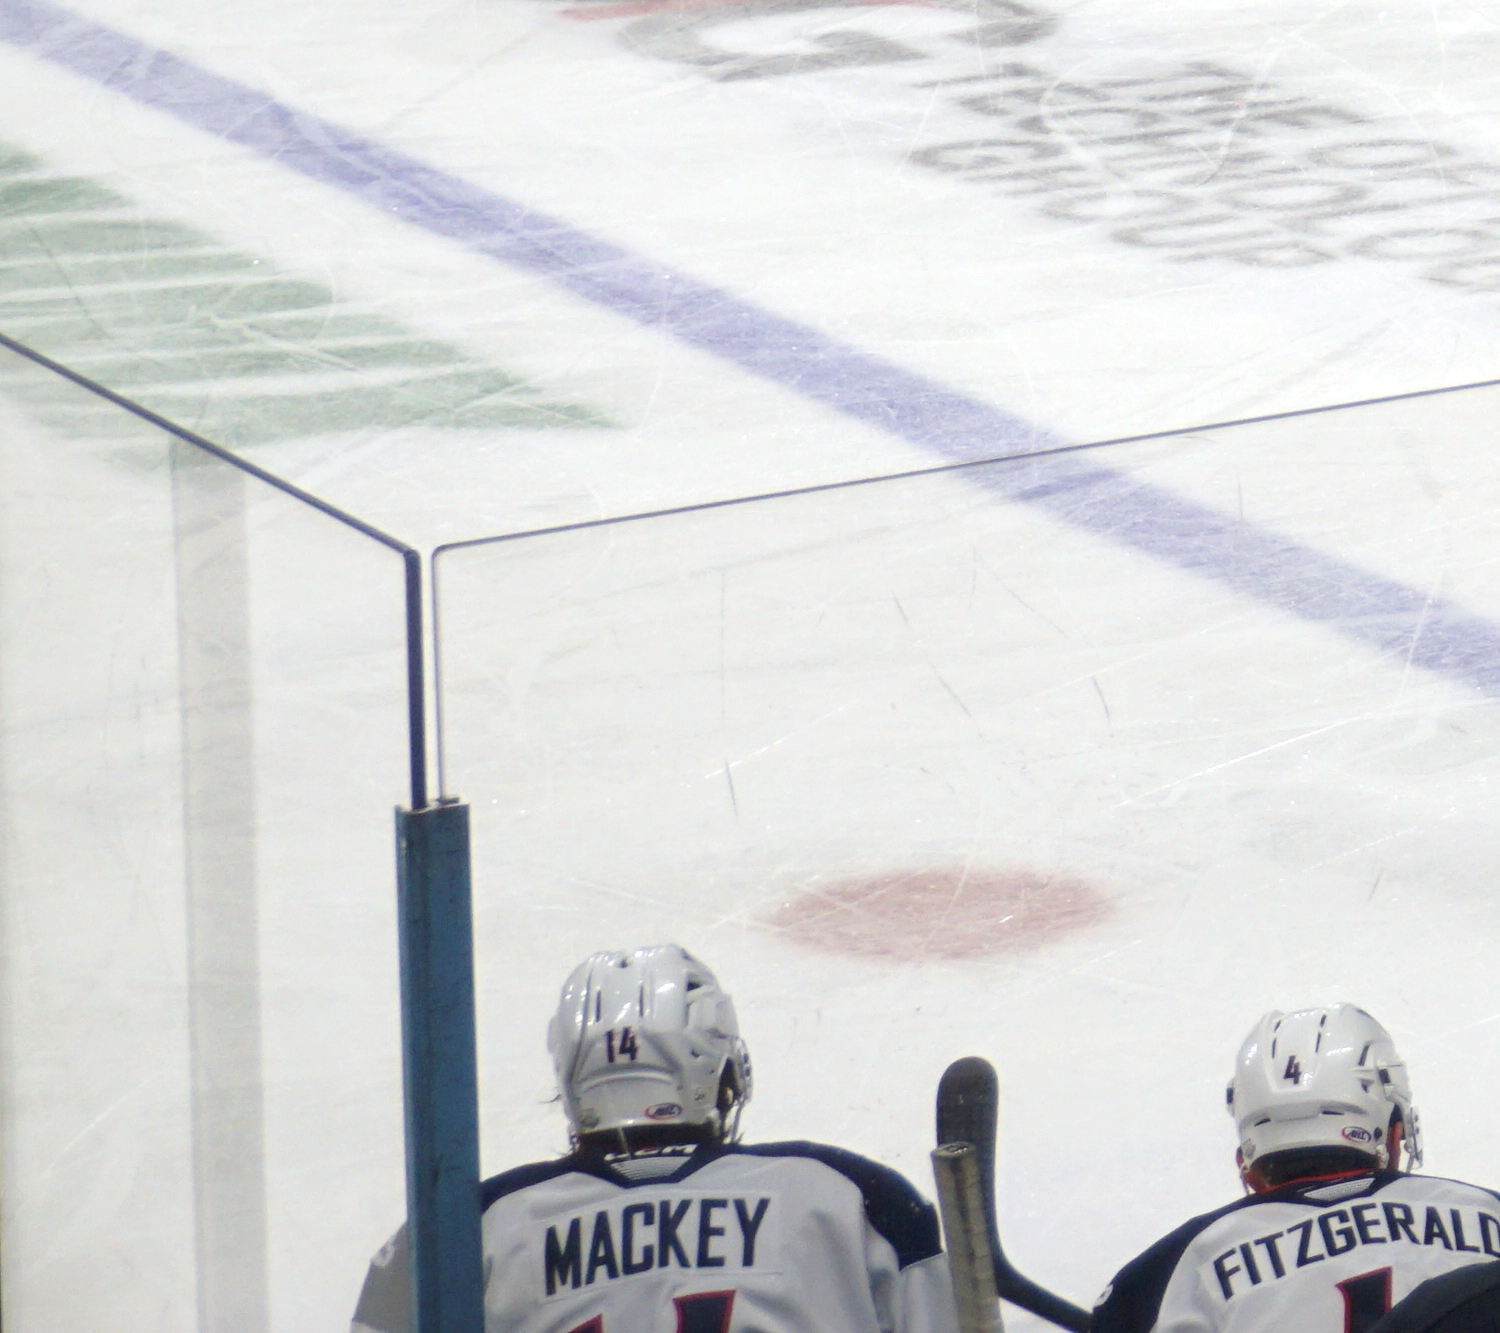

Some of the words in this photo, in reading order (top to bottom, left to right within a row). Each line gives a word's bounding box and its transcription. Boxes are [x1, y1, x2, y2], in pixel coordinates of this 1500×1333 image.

[604, 1025, 641, 1065] 14
[1283, 1054, 1304, 1086] 4
[544, 1195, 773, 1298] MACKEY
